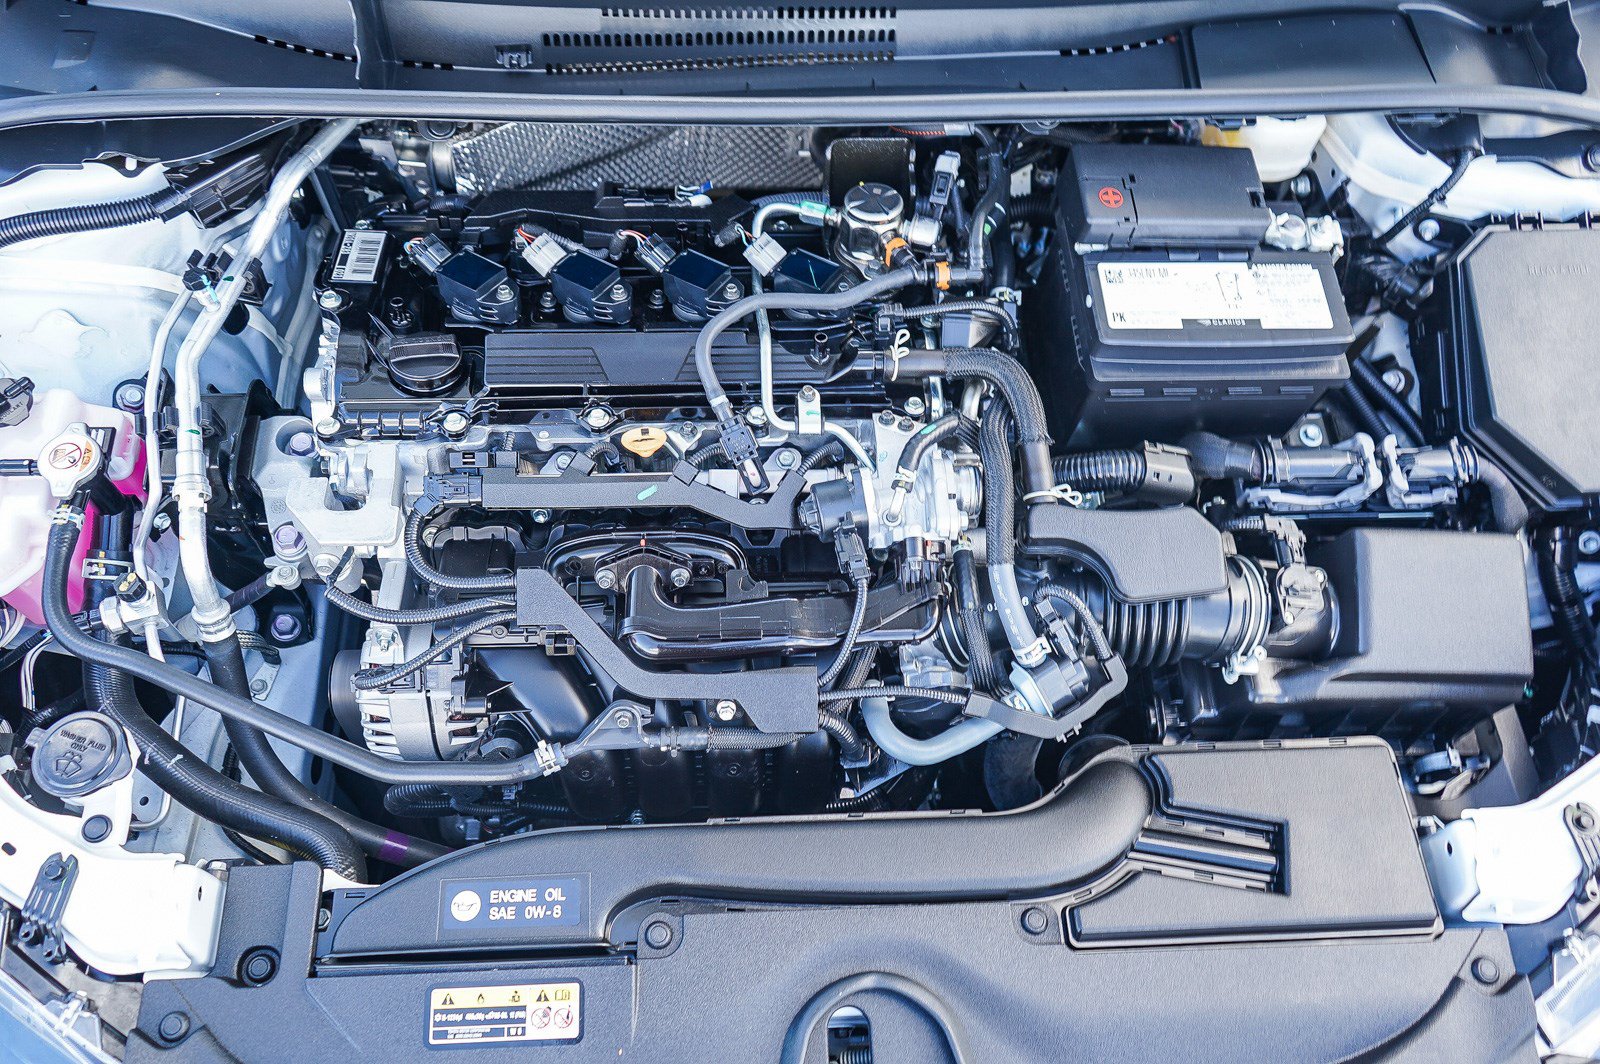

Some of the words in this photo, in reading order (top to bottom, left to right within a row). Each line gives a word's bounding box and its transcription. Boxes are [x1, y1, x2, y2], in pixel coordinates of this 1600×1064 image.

[60, 729, 87, 744] WASHER
[87, 739, 107, 752] FLUID
[70, 742, 88, 752] ONLY
[489, 888, 537, 903] ENGINE
[544, 887, 567, 902] OIL
[488, 906, 517, 920] SAE
[524, 904, 562, 920] 0W-8
